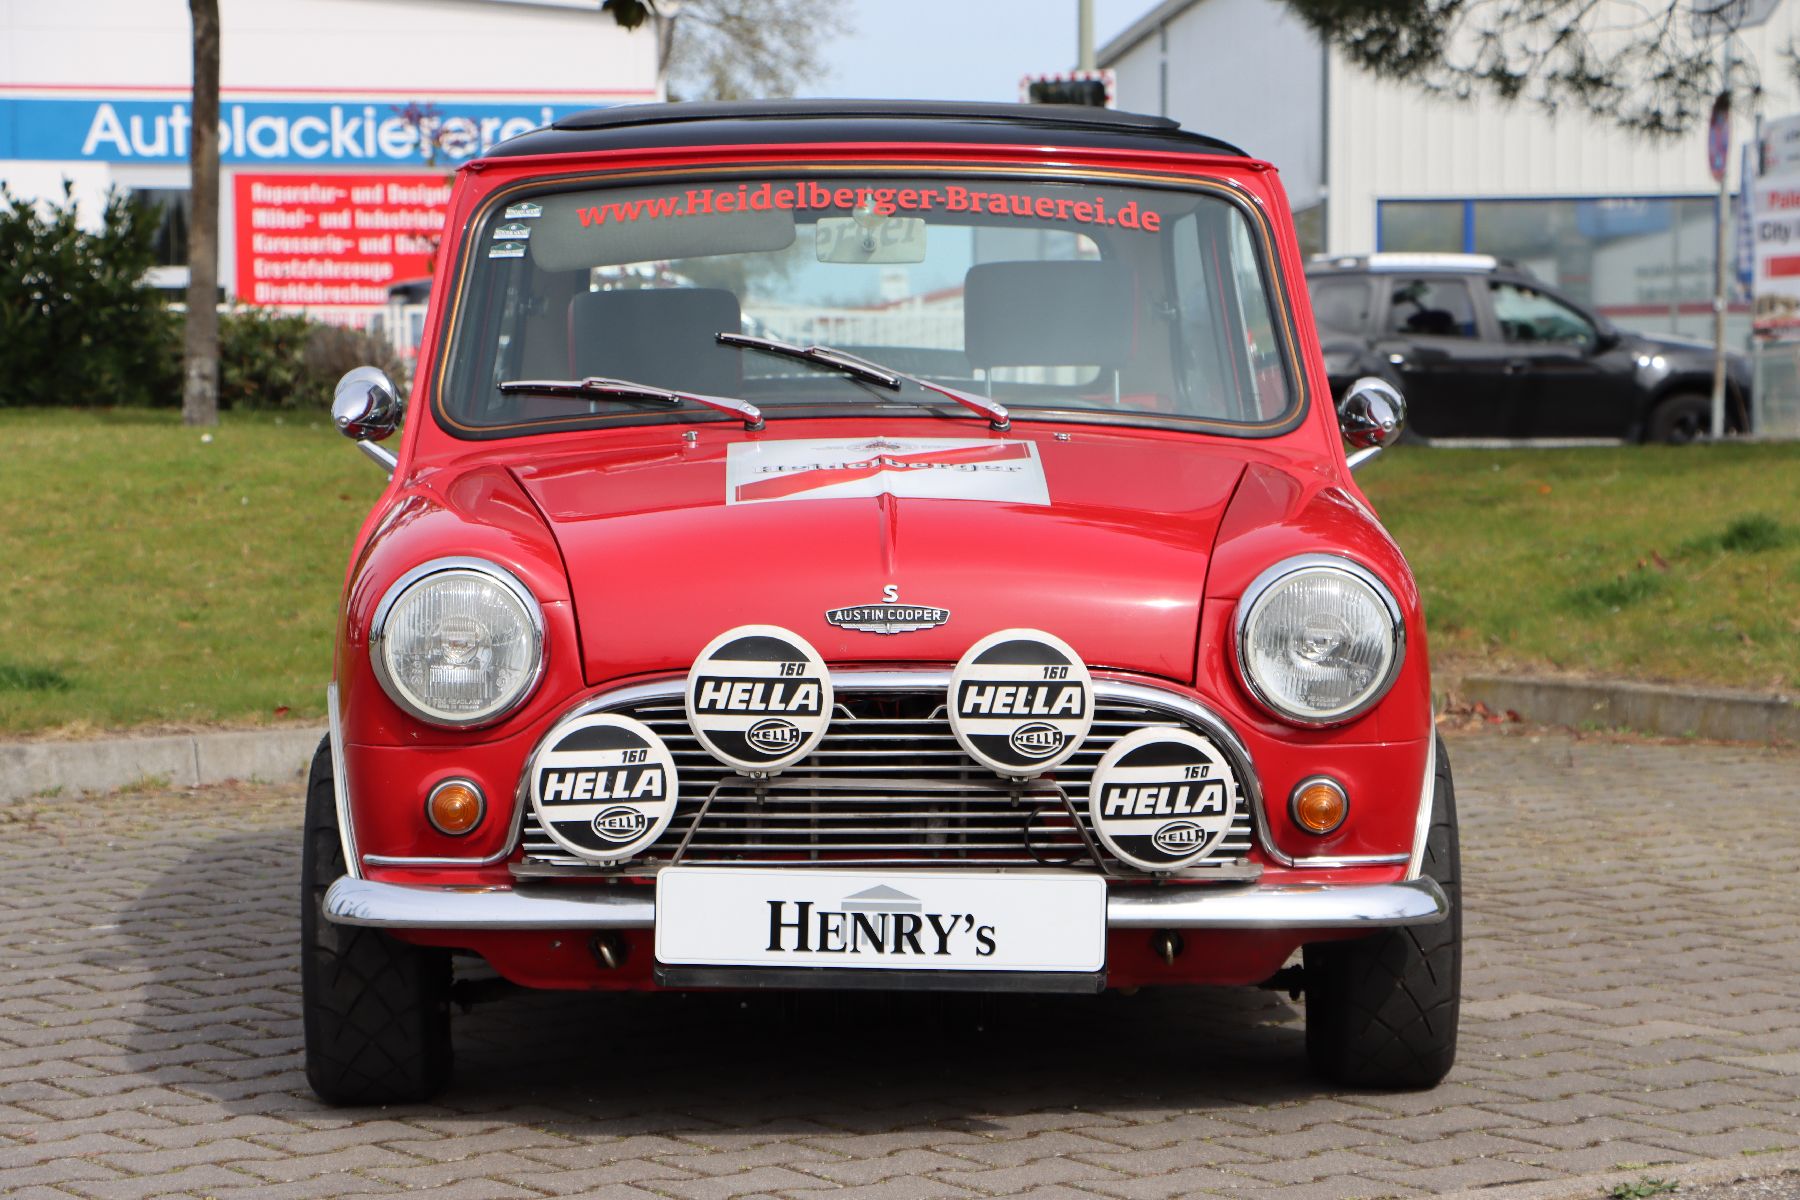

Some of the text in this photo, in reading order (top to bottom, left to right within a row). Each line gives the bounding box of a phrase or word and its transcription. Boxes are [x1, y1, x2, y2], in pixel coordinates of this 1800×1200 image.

[351, 184, 384, 204] und
[576, 181, 1162, 232] www.Heidelberger-Brauerei.de
[252, 207, 315, 229] Möbel-
[318, 208, 352, 229] und
[252, 233, 355, 254] Karosserie-
[358, 234, 393, 254] und
[253, 258, 394, 281] Ersatzfahrzeuge
[753, 456, 1024, 473] Heidelberger
[882, 584, 899, 603] S
[834, 609, 941, 621] AUSTIN COOPER
[779, 663, 806, 676] 160
[1043, 666, 1069, 679] 160
[698, 681, 819, 711] HELLA
[961, 685, 1082, 715] HELLA
[751, 727, 800, 743] HELLA
[1015, 731, 1063, 746] HELLA
[622, 749, 648, 763] 160
[1184, 765, 1210, 779] 160
[543, 769, 662, 801] HELLA
[1104, 784, 1223, 816] HELLA
[597, 814, 645, 829] HELLA
[1158, 828, 1205, 843] HELLA
